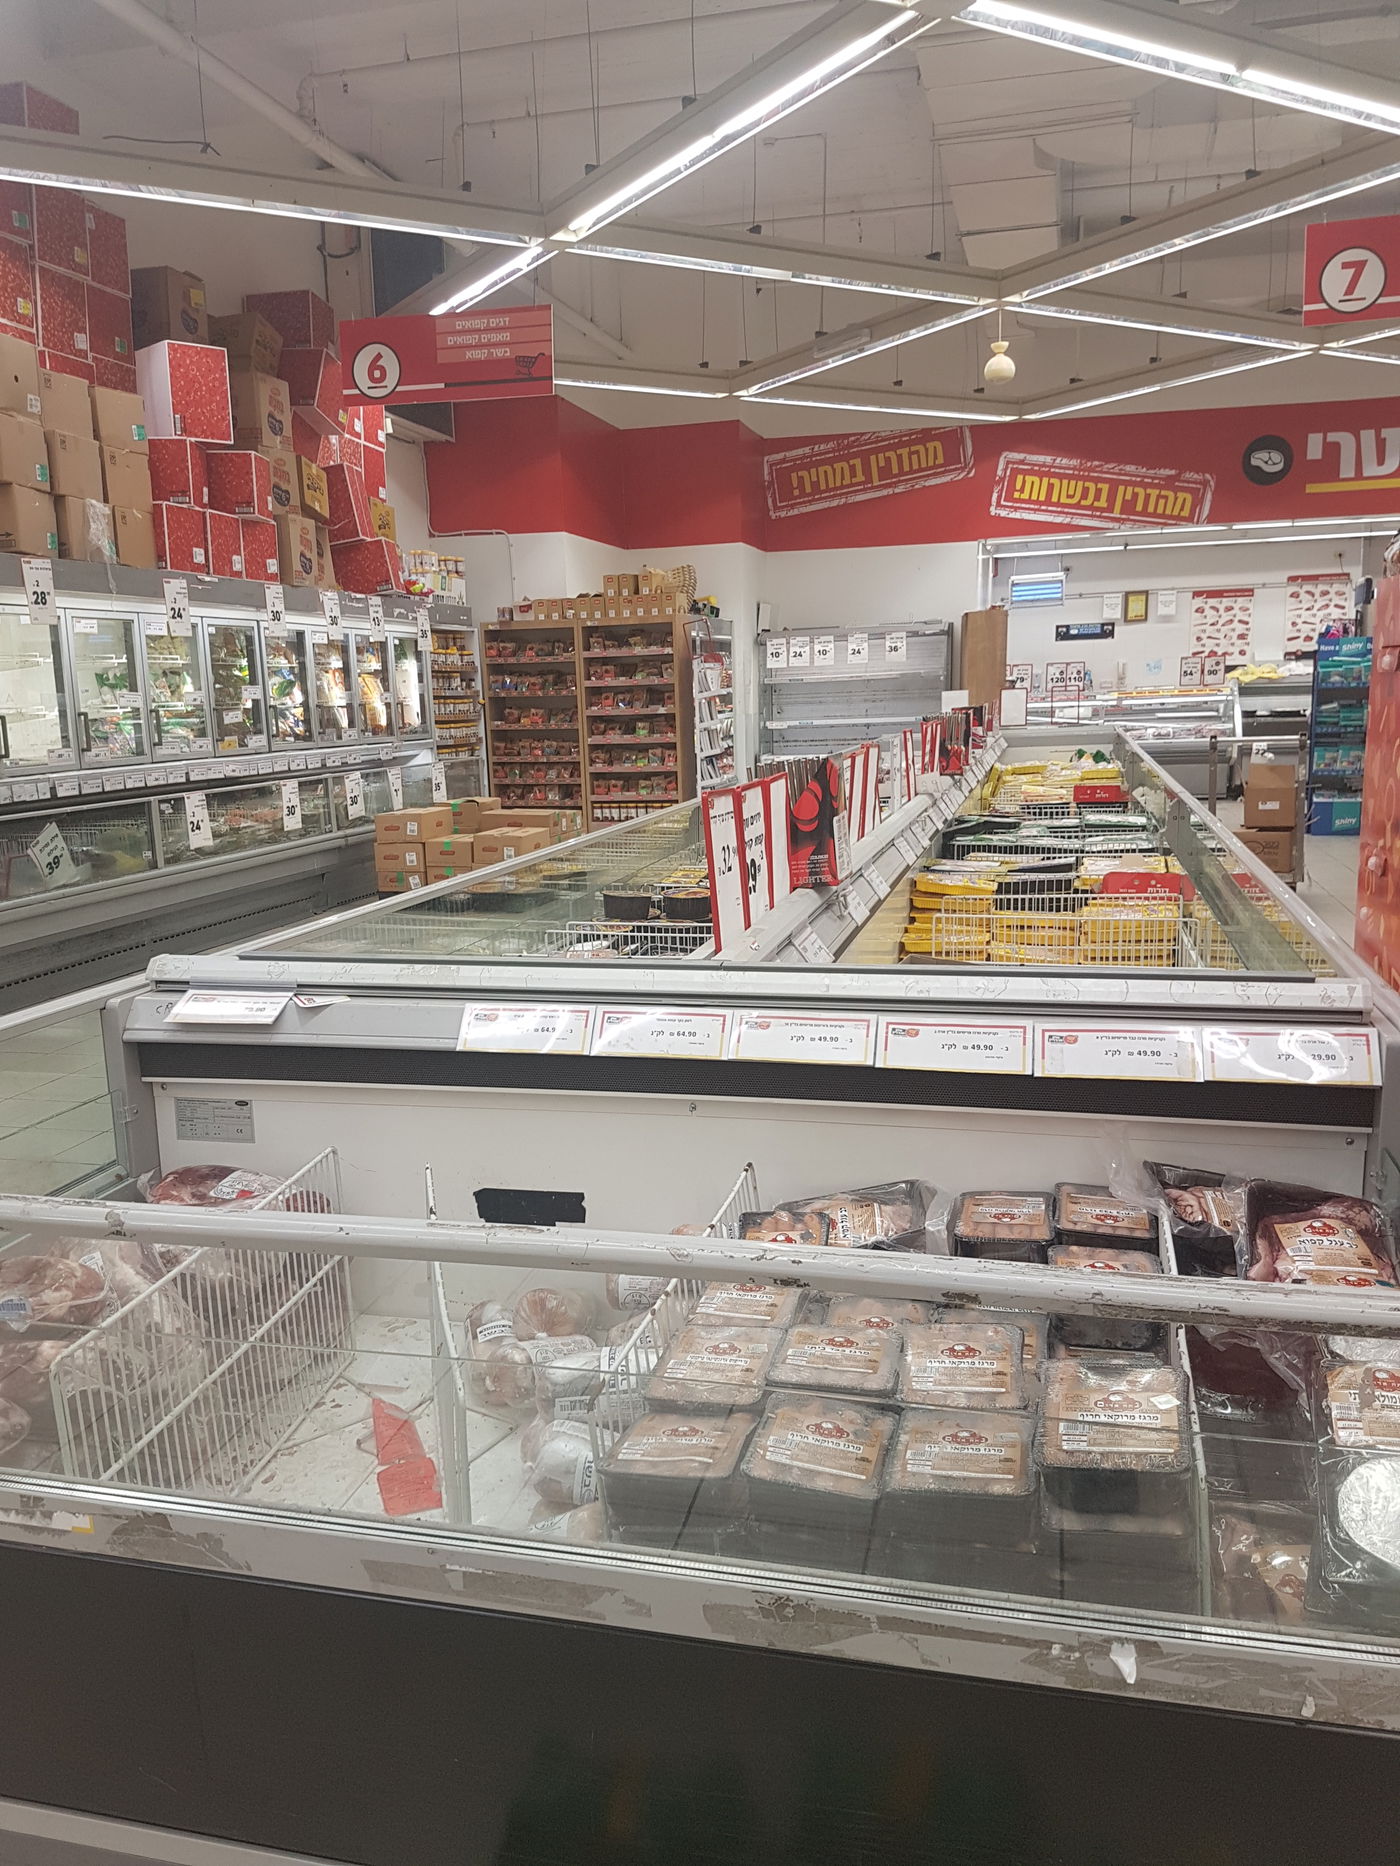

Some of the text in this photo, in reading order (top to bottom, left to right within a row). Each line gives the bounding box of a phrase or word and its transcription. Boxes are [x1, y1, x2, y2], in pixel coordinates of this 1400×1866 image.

[1341, 259, 1368, 296] 7
[456, 317, 510, 330] דגים קפואים
[447, 332, 510, 345] מאפים קפואים
[465, 347, 510, 360] בשר קפוא
[367, 352, 387, 384] 6
[1306, 427, 1400, 479] טרי
[790, 440, 944, 496] מהדרין במחיר!
[1013, 474, 1193, 517] מהדרין בכשרות!
[170, 607, 182, 620] 24
[271, 610, 280, 622] 30
[349, 795, 358, 806] 30
[286, 805, 296, 816] 30
[190, 820, 201, 832] 24
[1335, 817, 1357, 826] Shiny
[794, 874, 835, 886] LIGHTER
[1298, 1238, 1324, 1246] קפוא
[1326, 1238, 1345, 1246] עגל
[1080, 1412, 1101, 1420] חריף
[1104, 1413, 1136, 1422] מרוקאי
[790, 1432, 862, 1452] מרגז מרוקאי חריף
[950, 1445, 981, 1453] מרוקאי
